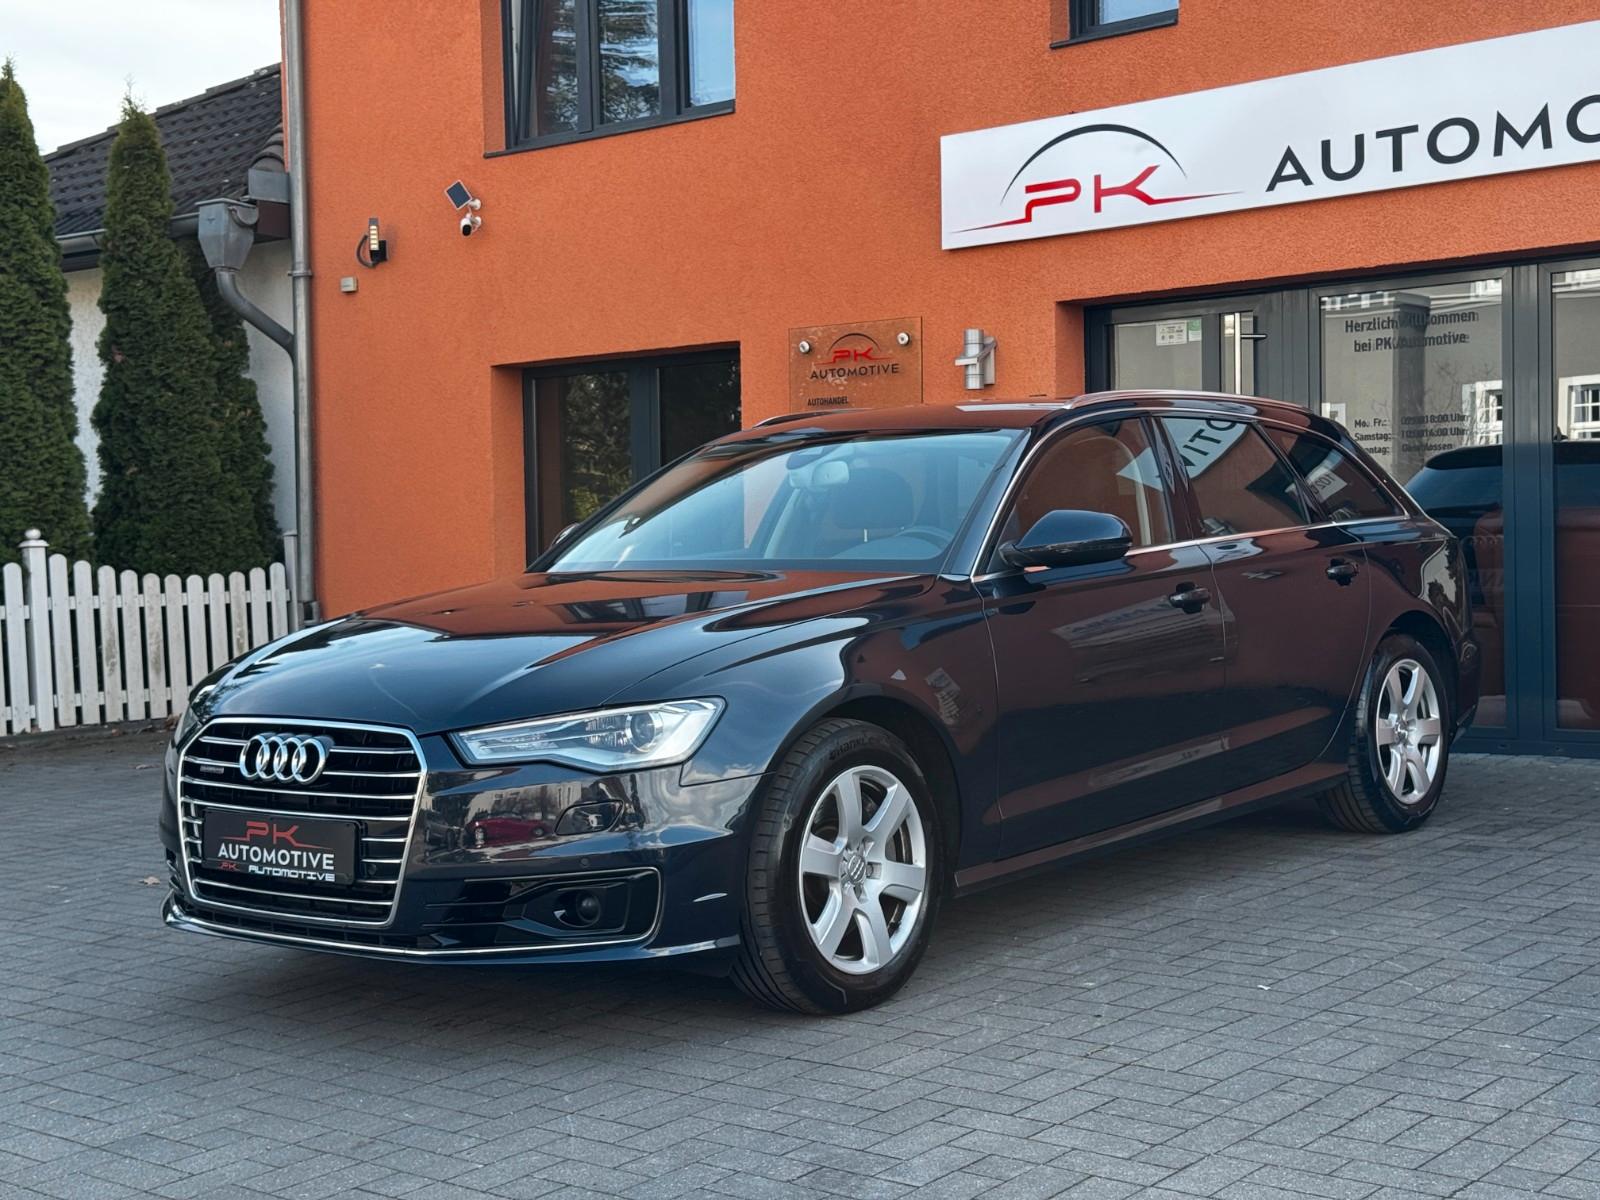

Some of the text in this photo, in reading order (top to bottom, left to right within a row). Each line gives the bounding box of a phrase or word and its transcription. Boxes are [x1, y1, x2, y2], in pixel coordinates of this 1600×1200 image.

[1000, 94, 1600, 225] PK AUTOMO
[1345, 316, 1395, 333] Herzlich
[1354, 339, 1371, 352] bei
[1376, 337, 1392, 350] PK
[825, 346, 883, 366] PK
[810, 363, 900, 380] AUTOMOTIVE
[233, 820, 316, 847] PK
[217, 842, 335, 870] AUTOMOTIVE
[248, 864, 336, 882] AUTOMOTIVE
